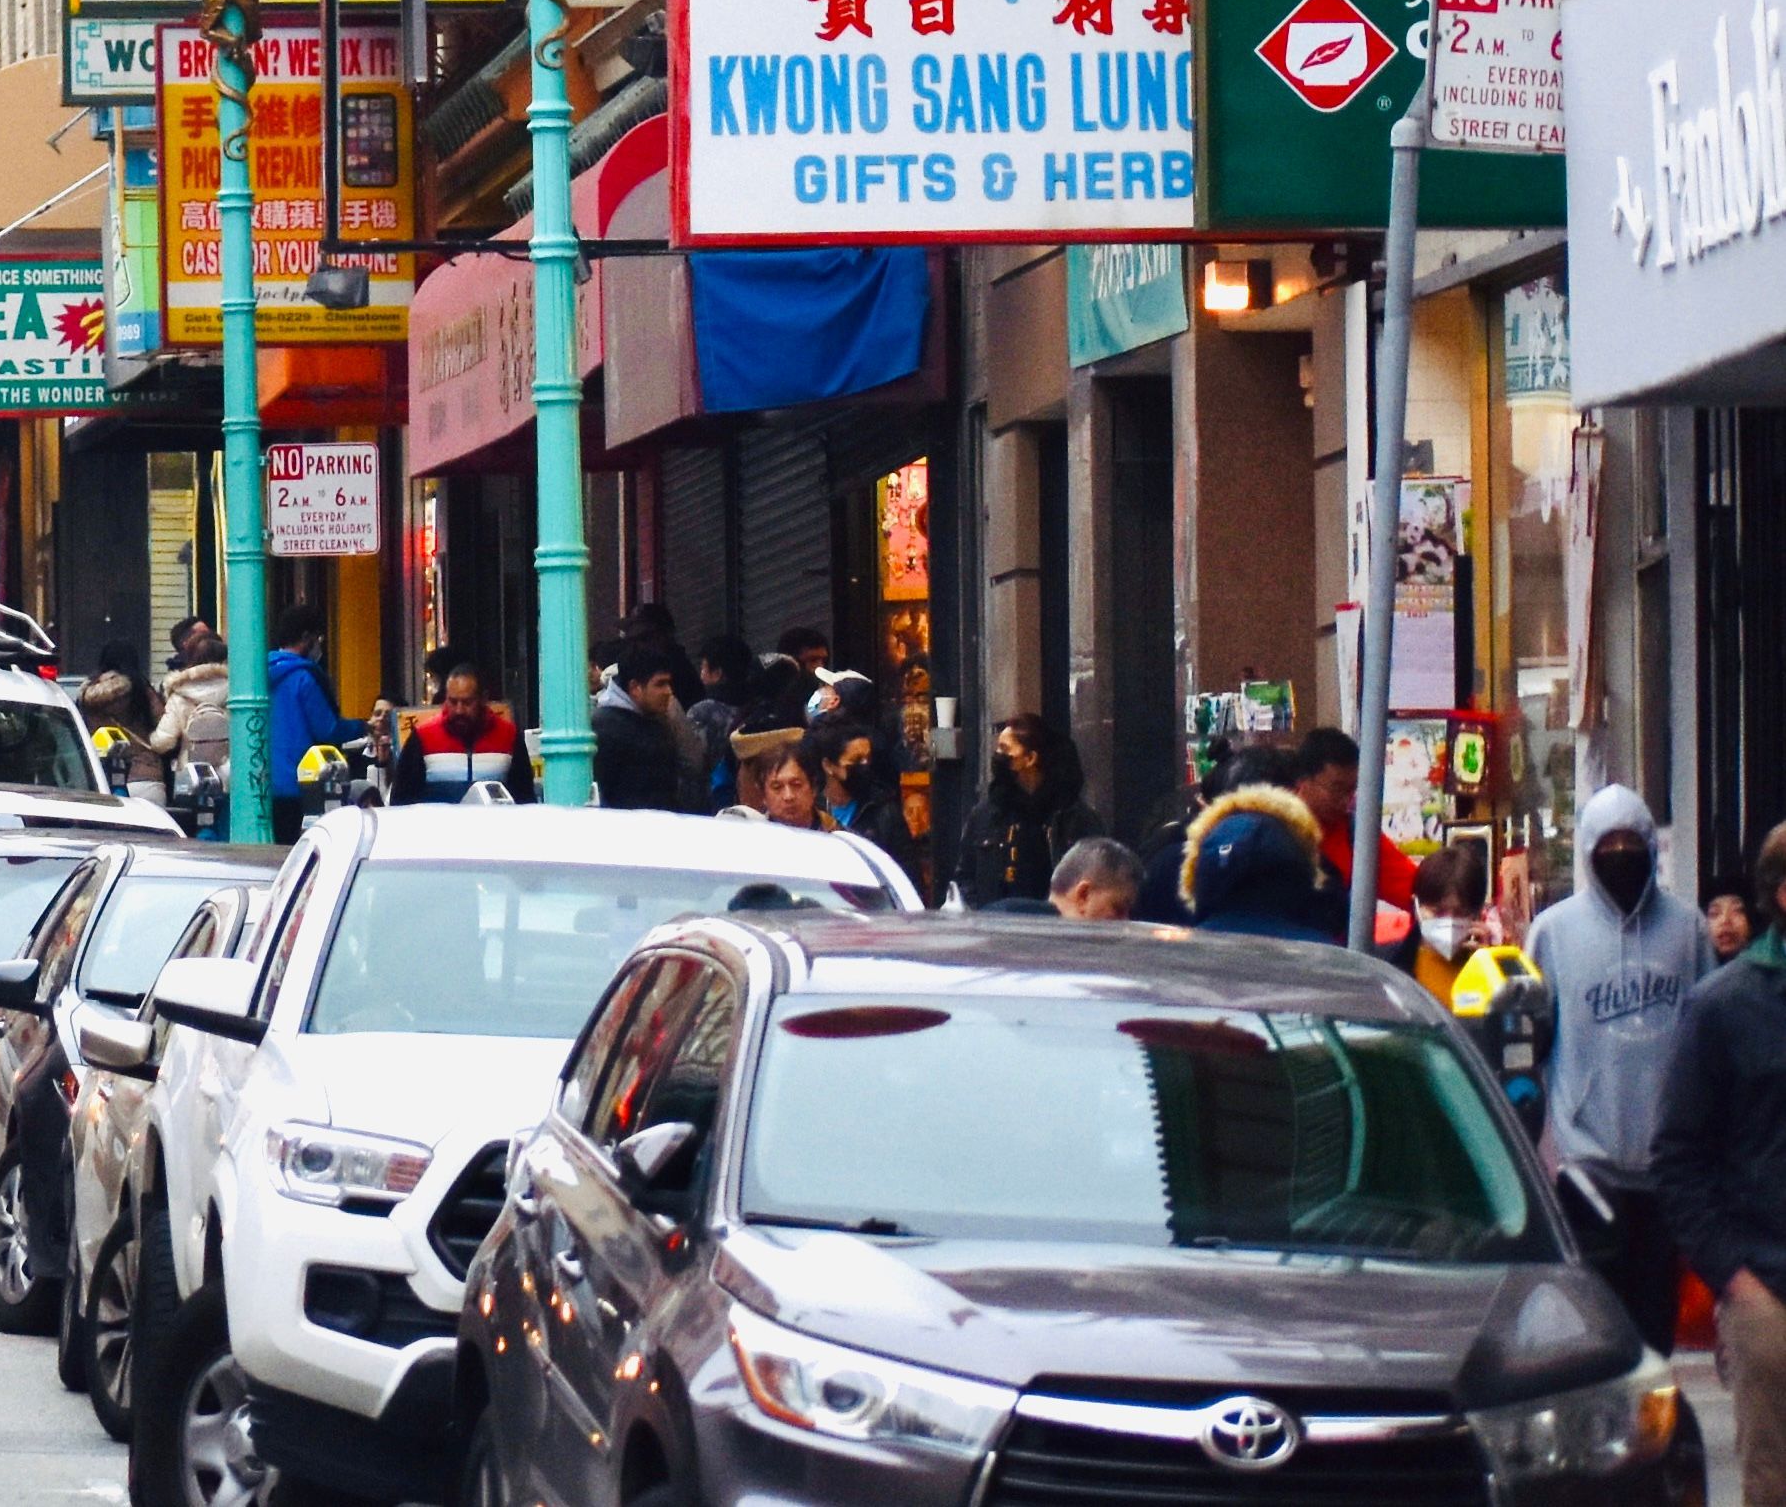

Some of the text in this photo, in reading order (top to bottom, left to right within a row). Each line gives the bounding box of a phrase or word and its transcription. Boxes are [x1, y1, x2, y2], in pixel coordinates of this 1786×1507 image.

[1451, 18, 1534, 57] 2 A.M. TO
[179, 39, 281, 77] BRON?
[287, 38, 320, 76] WE
[709, 53, 889, 136] KWONG
[911, 52, 1047, 134] SANG
[1443, 85, 1527, 108] INCLUDING
[181, 95, 321, 139] 手維修
[1449, 118, 1511, 138] STREET
[182, 147, 221, 190] PHO
[794, 152, 957, 204] GIFTS
[981, 152, 1019, 202] &
[181, 199, 397, 231] 高購蘋手機
[182, 241, 222, 274] CAS
[23, 268, 105, 286] SOMETHING
[0, 387, 31, 404] THE
[37, 386, 106, 404] WONDER
[272, 449, 373, 477] NO PARKING
[278, 487, 289, 507] 2
[335, 487, 346, 507] 6
[276, 523, 373, 535] INCLUDING HOLIDAYS
[301, 512, 347, 522] EVERYDAY
[283, 539, 366, 550] STREET CLEANING
[1585, 973, 1681, 1022] Hurley
